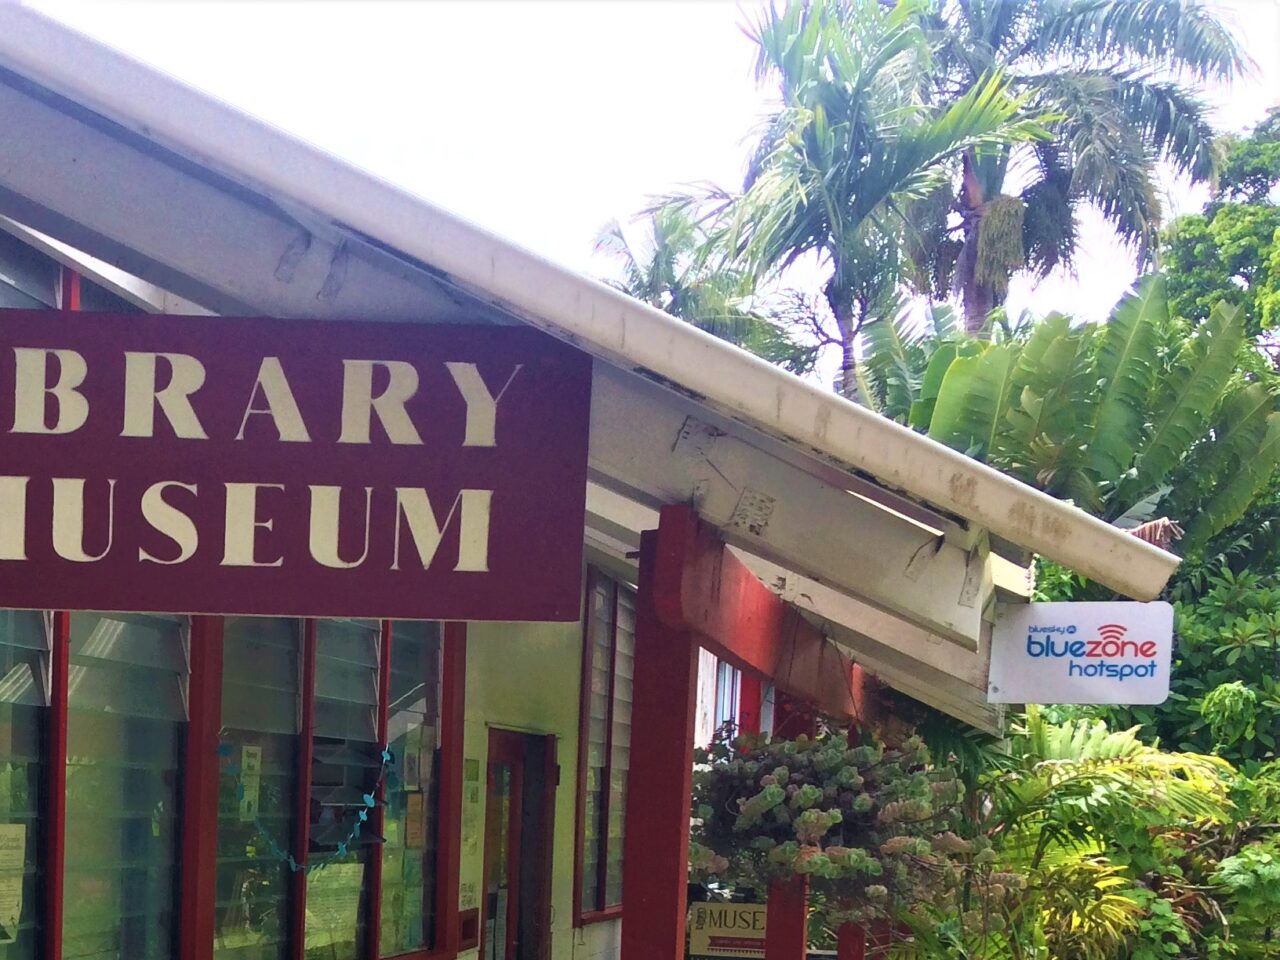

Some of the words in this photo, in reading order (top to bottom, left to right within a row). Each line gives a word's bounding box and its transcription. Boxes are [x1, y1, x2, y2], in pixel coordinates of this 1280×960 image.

[1028, 625, 1065, 635] bluesky
[1027, 635, 1157, 658] bluezone
[1069, 660, 1157, 681] hotspot
[709, 909, 766, 931] MUSE
